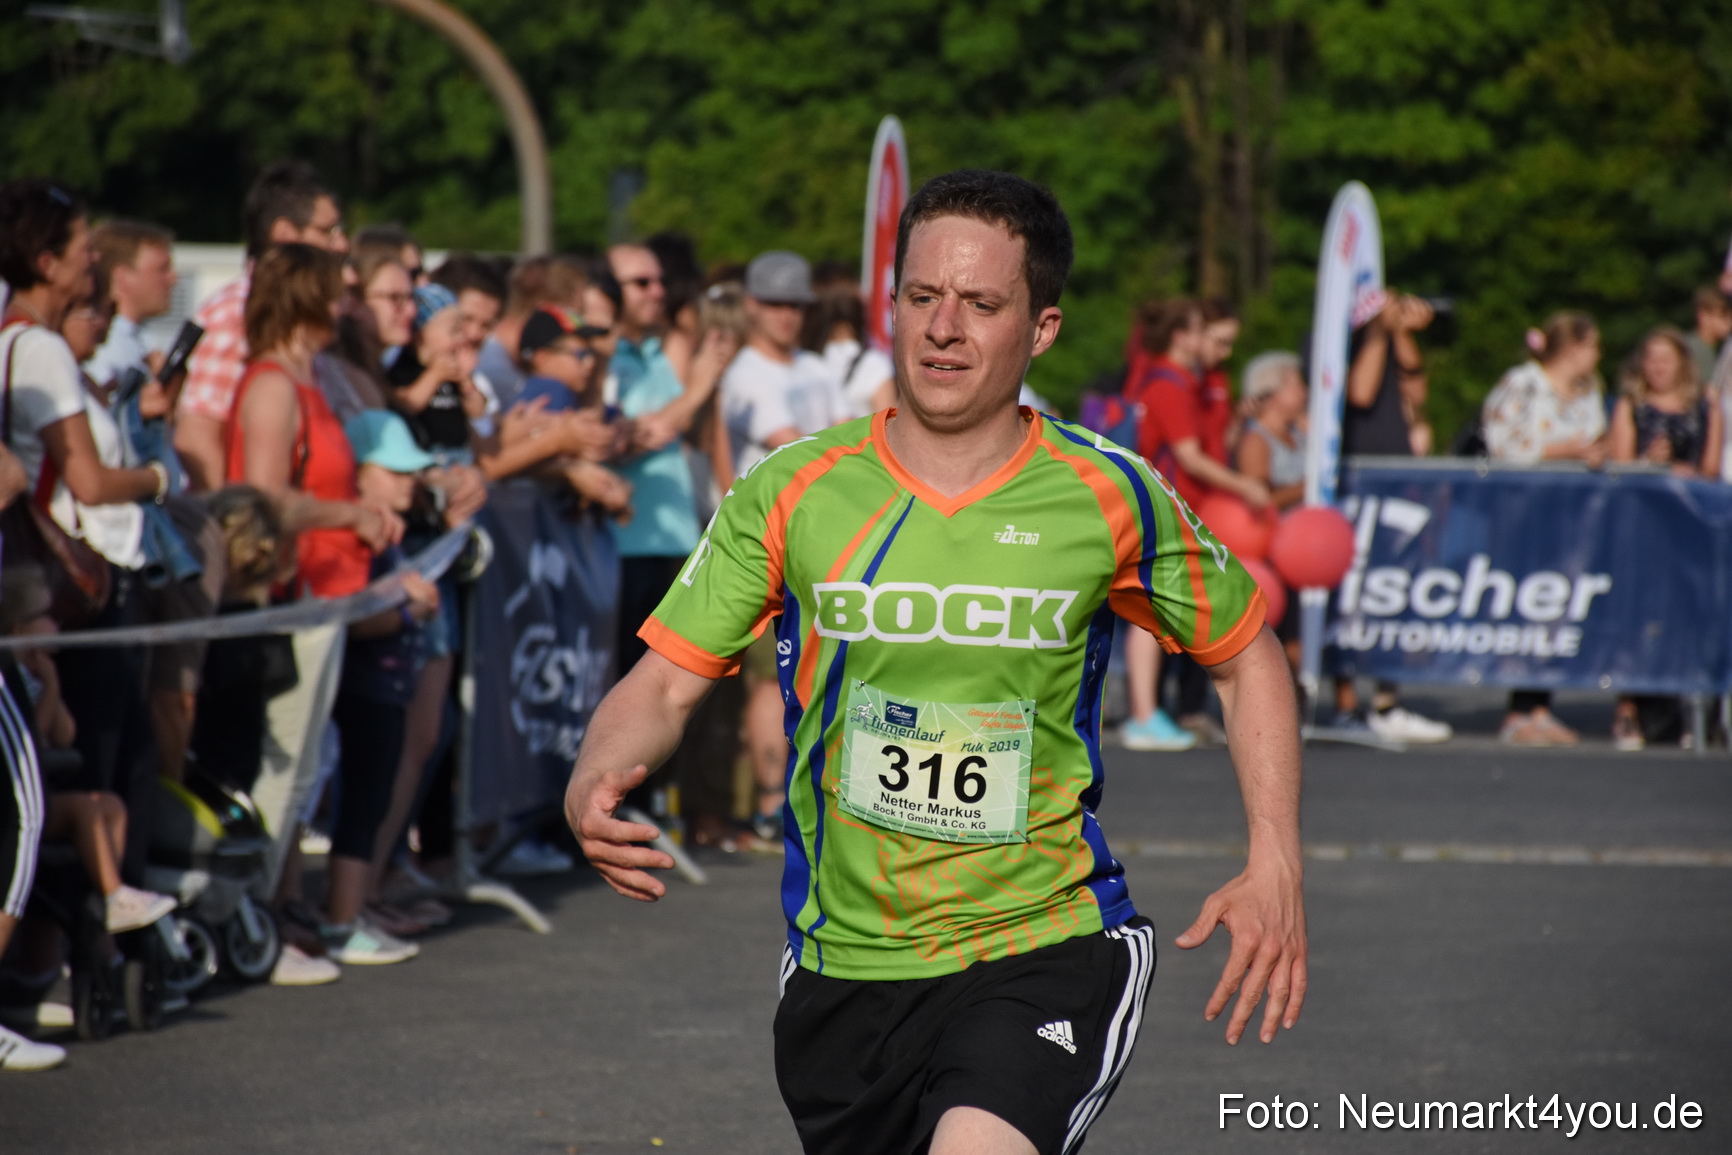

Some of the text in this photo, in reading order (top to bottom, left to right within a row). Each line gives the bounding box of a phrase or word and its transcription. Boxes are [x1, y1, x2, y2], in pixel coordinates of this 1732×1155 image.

[995, 524, 1040, 545] ACTON
[812, 582, 1080, 649] BOCK
[870, 715, 946, 743] firmenlauf
[960, 739, 1021, 753] run 2019
[878, 745, 988, 804] 316
[872, 803, 986, 830] Bock 1 GmbH & Co. KG
[880, 791, 982, 819] Netter Markus
[1036, 1027, 1077, 1054] adidas
